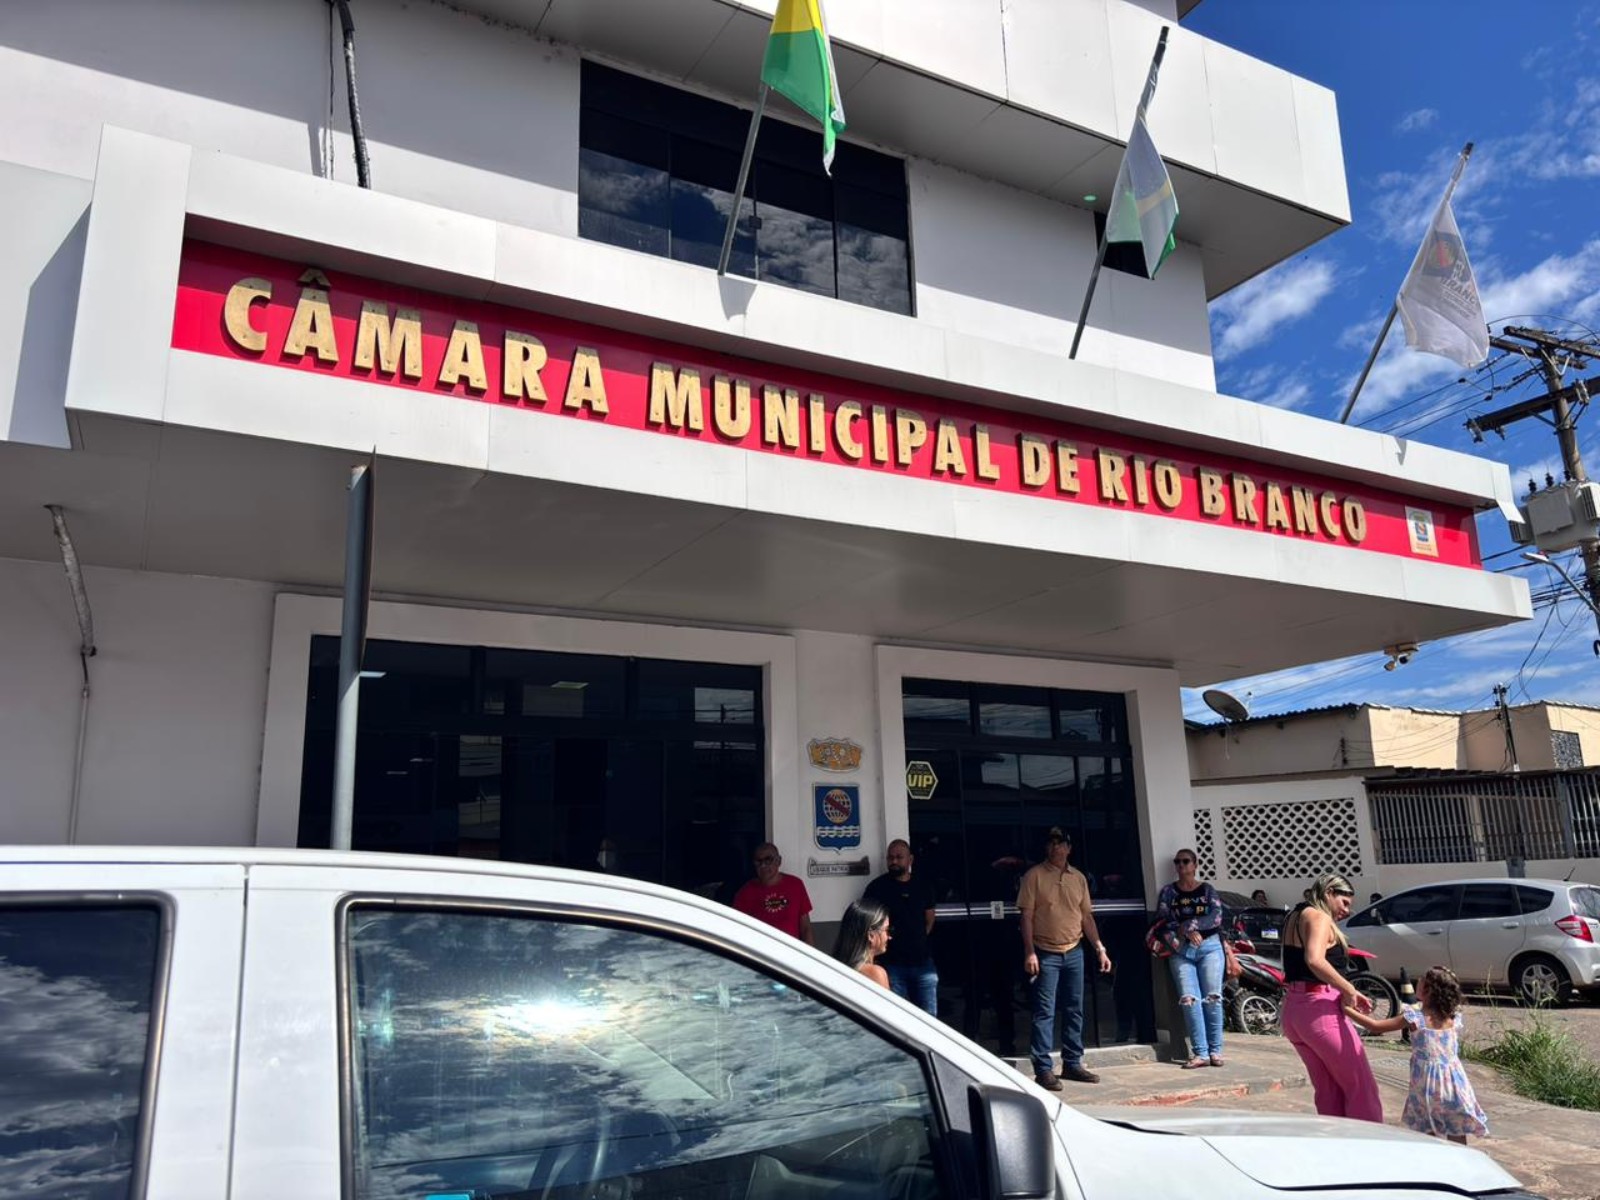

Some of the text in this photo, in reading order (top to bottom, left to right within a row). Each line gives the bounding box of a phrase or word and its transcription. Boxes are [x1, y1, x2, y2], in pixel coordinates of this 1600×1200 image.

[222, 268, 1367, 544] CÂMARA MUNICIPAL DE RIO BRANCO
[907, 773, 933, 788] VIP
